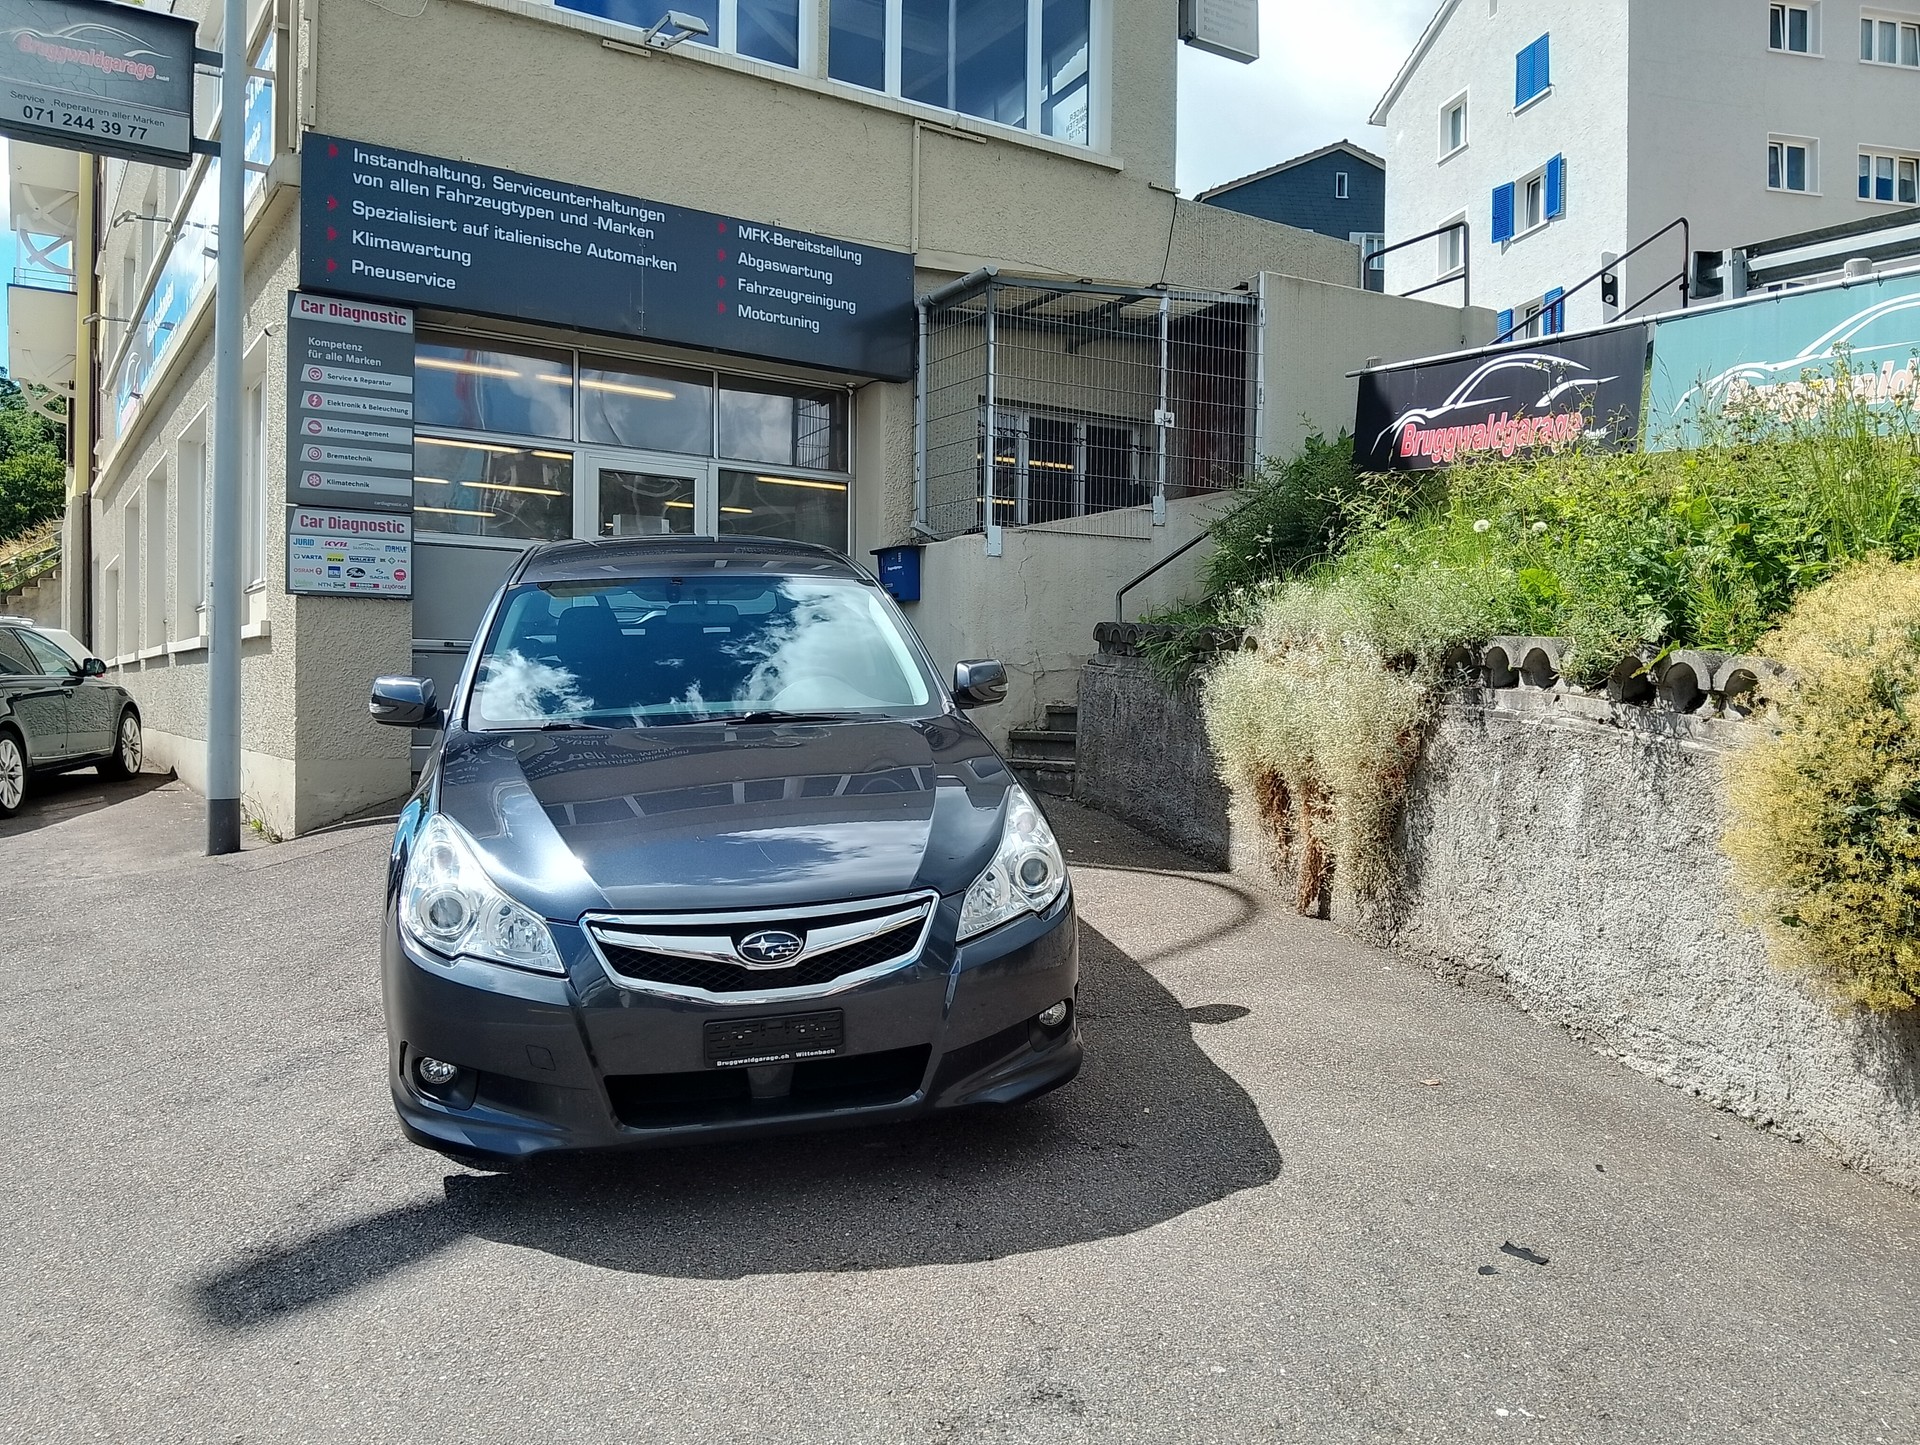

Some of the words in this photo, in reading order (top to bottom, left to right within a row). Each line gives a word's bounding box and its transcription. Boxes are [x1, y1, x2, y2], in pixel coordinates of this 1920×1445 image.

[17, 33, 155, 81] Bruggwaldgarage
[10, 90, 45, 104] Service
[112, 108, 131, 121] aller
[133, 113, 165, 128] Marken
[23, 105, 54, 123] 071
[62, 112, 95, 131] 244
[101, 120, 122, 136] 39
[127, 124, 148, 140] 77
[353, 148, 486, 190] Instandhaltung,
[493, 176, 665, 223] Serviceunterhaltungen
[353, 172, 384, 189] von
[390, 177, 430, 198] allen
[436, 185, 555, 222] Fahrzeugtypen
[560, 209, 588, 226] und
[593, 217, 655, 240] -Marken
[352, 200, 458, 232] Spezialisiert
[462, 222, 489, 239] auf
[494, 227, 582, 255] italienische
[586, 244, 678, 272] Automarken
[352, 229, 472, 267] Klimawartung
[738, 225, 862, 265] MFK-Bereitstellung
[352, 259, 457, 290] Pneuservice
[738, 252, 833, 285] Abgaswartung
[738, 278, 857, 315] Fahrzeugreinigung
[300, 299, 326, 315] Car
[329, 303, 407, 327] Diagnostic
[738, 304, 820, 333] Motortuning
[308, 336, 363, 352] Kompetenz
[308, 349, 322, 360] für
[325, 352, 343, 363] alle
[346, 355, 382, 367] Marken
[327, 373, 352, 383] Service
[360, 377, 392, 387] Reparatur
[327, 400, 361, 409] Elektronik
[369, 404, 409, 415] Beleuchtung
[327, 425, 389, 438] Motormanagement
[327, 452, 373, 462] Bremstechnik
[327, 479, 370, 488] Klimatechnik
[300, 515, 325, 528] Car
[328, 516, 405, 533] Diagnostic
[293, 538, 315, 546] JURID
[717, 1053, 789, 1066] Bruggwaldgarage.ch
[796, 1048, 835, 1058] Wittenbach
